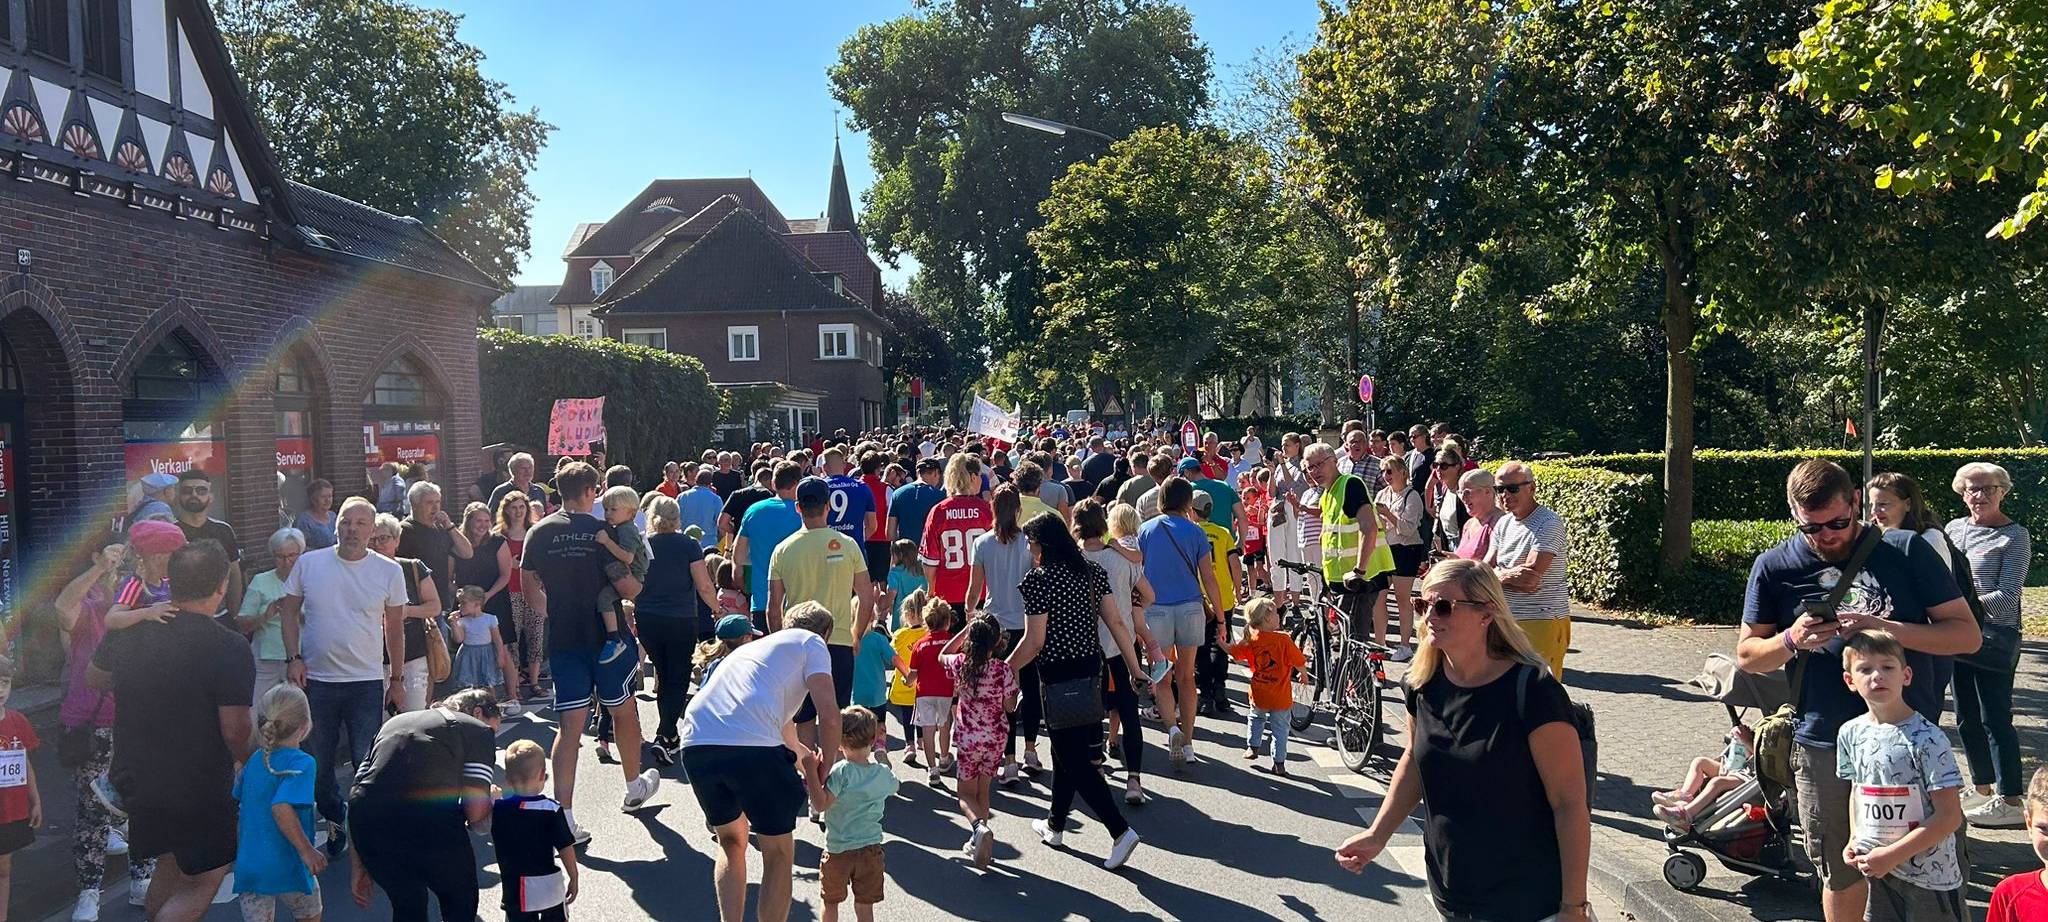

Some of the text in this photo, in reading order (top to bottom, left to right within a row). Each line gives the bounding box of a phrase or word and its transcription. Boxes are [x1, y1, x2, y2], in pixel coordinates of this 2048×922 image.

[19, 250, 30, 264] 23
[275, 451, 306, 467] Service
[396, 446, 426, 461] Reparatur
[150, 455, 194, 475] Verkauf
[829, 489, 848, 523] 9
[1863, 803, 1907, 821] 7007
